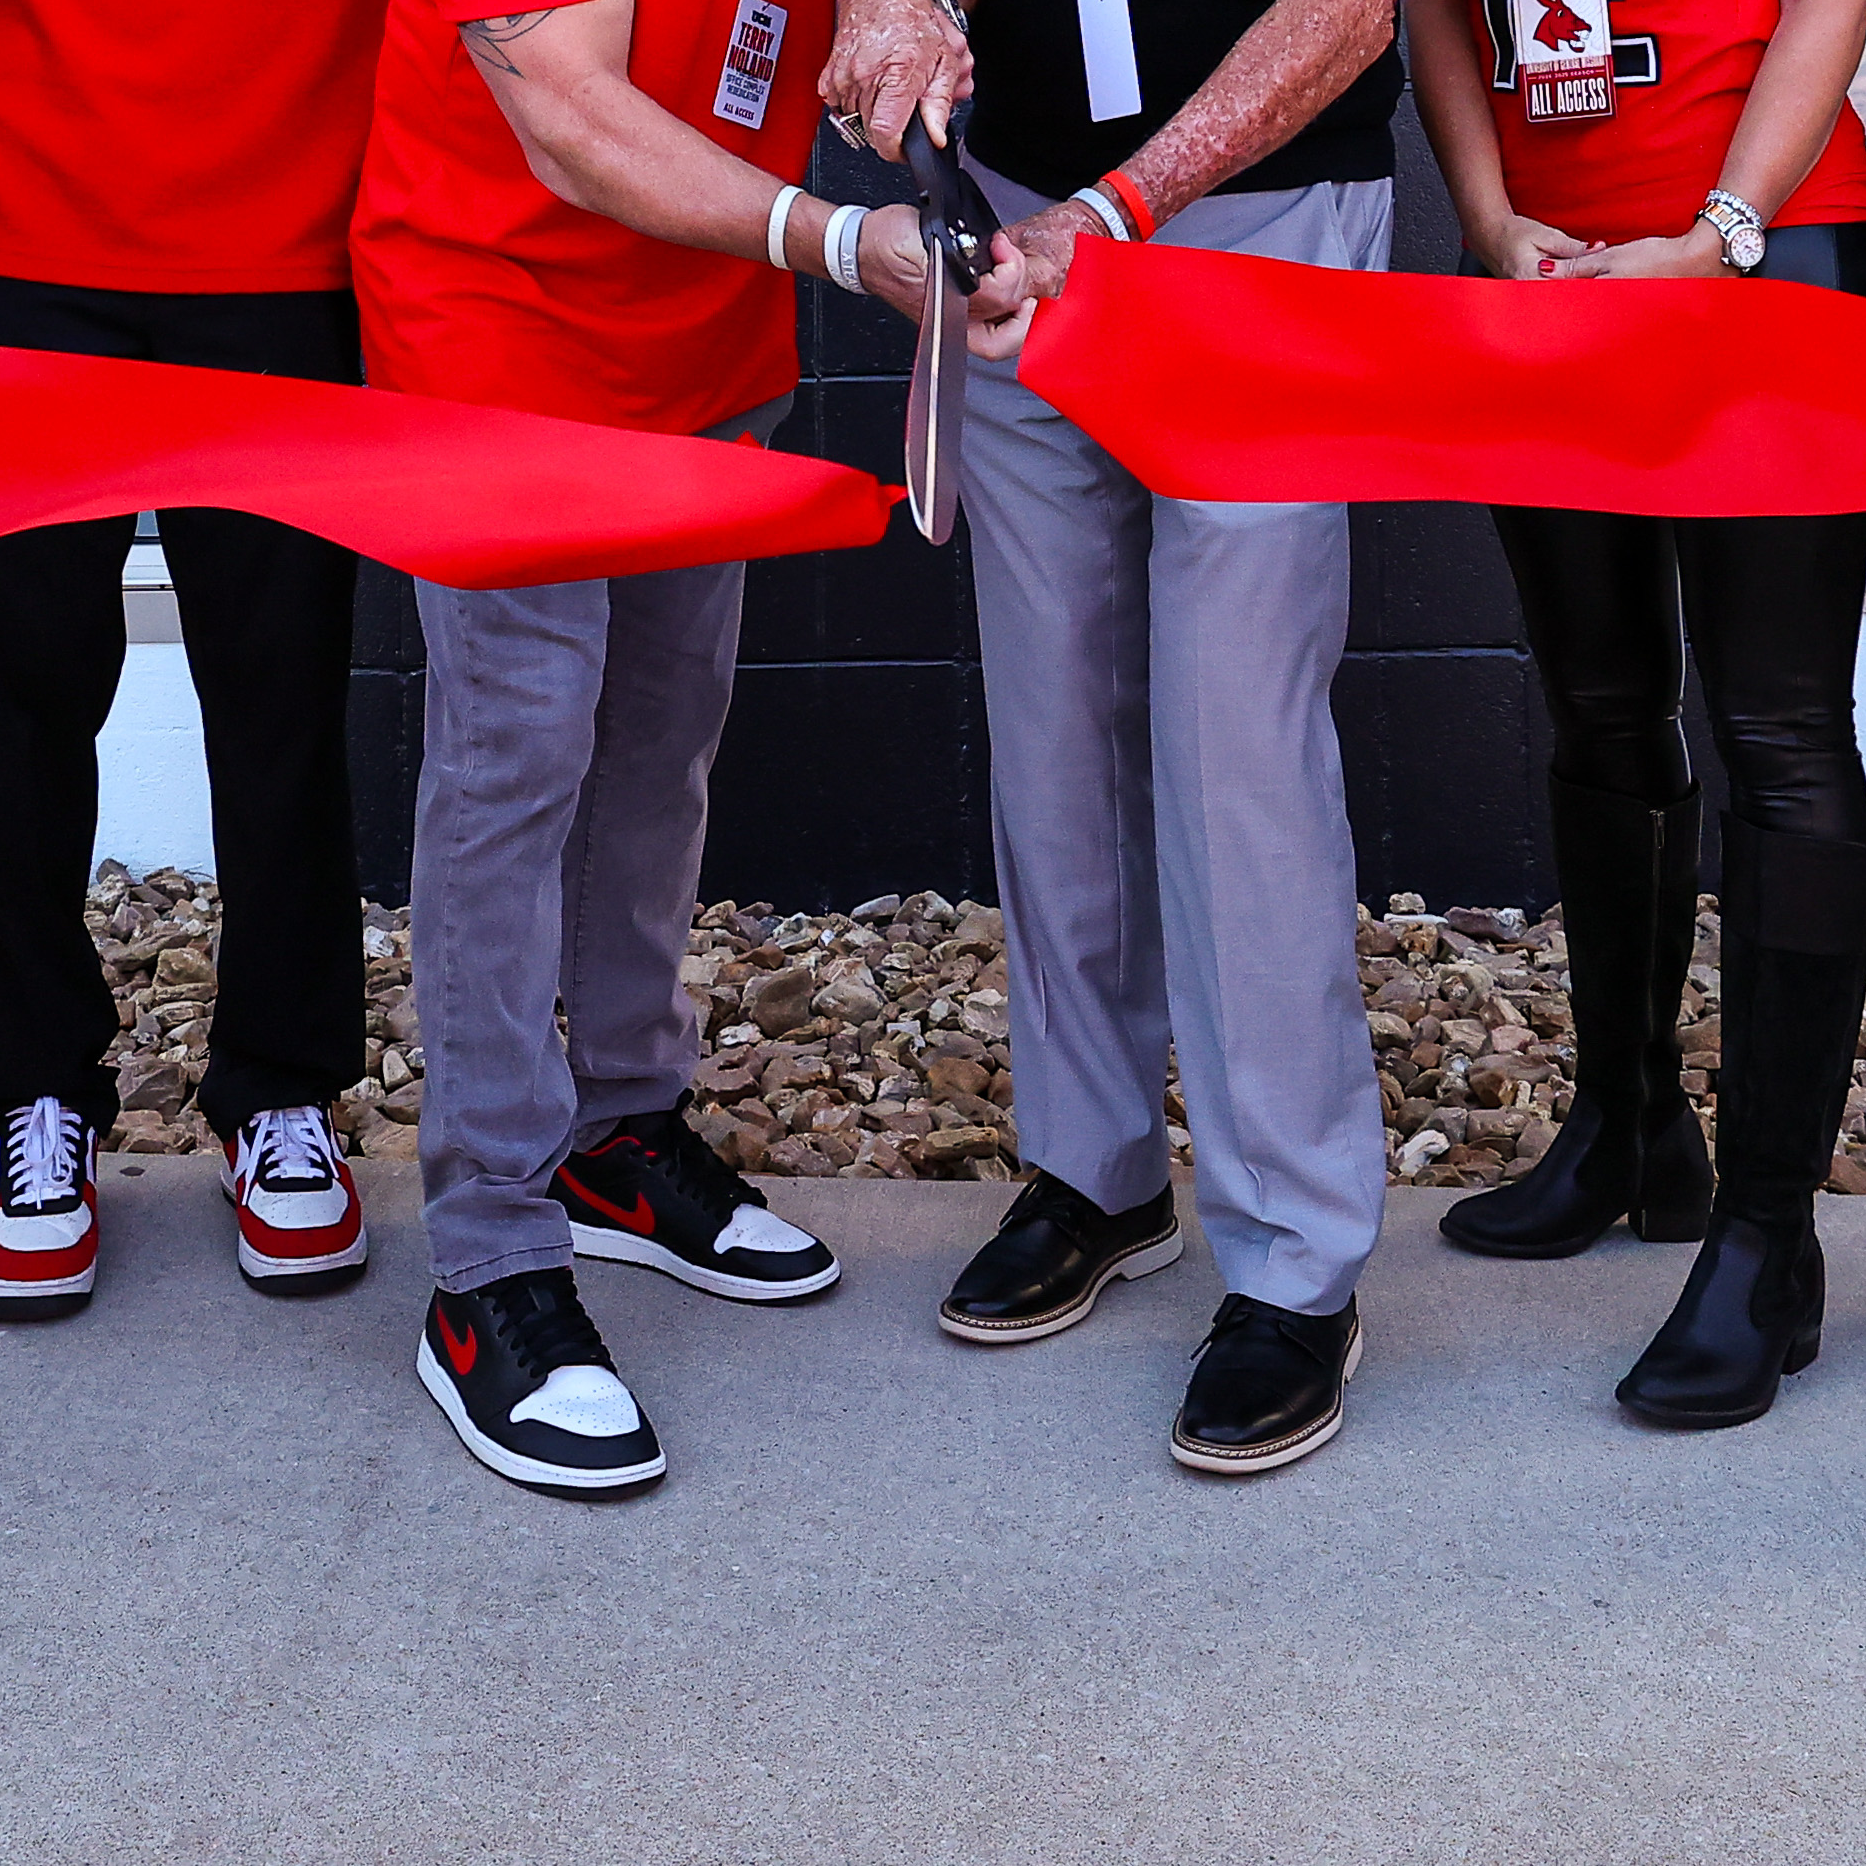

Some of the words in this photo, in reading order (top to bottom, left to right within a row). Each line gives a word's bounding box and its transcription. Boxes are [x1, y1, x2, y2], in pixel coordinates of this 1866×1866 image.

[738, 21, 775, 56] TERRY
[726, 44, 774, 82] NOLAND
[1531, 83, 1553, 116] ALL
[1557, 77, 1607, 114] ACCESS
